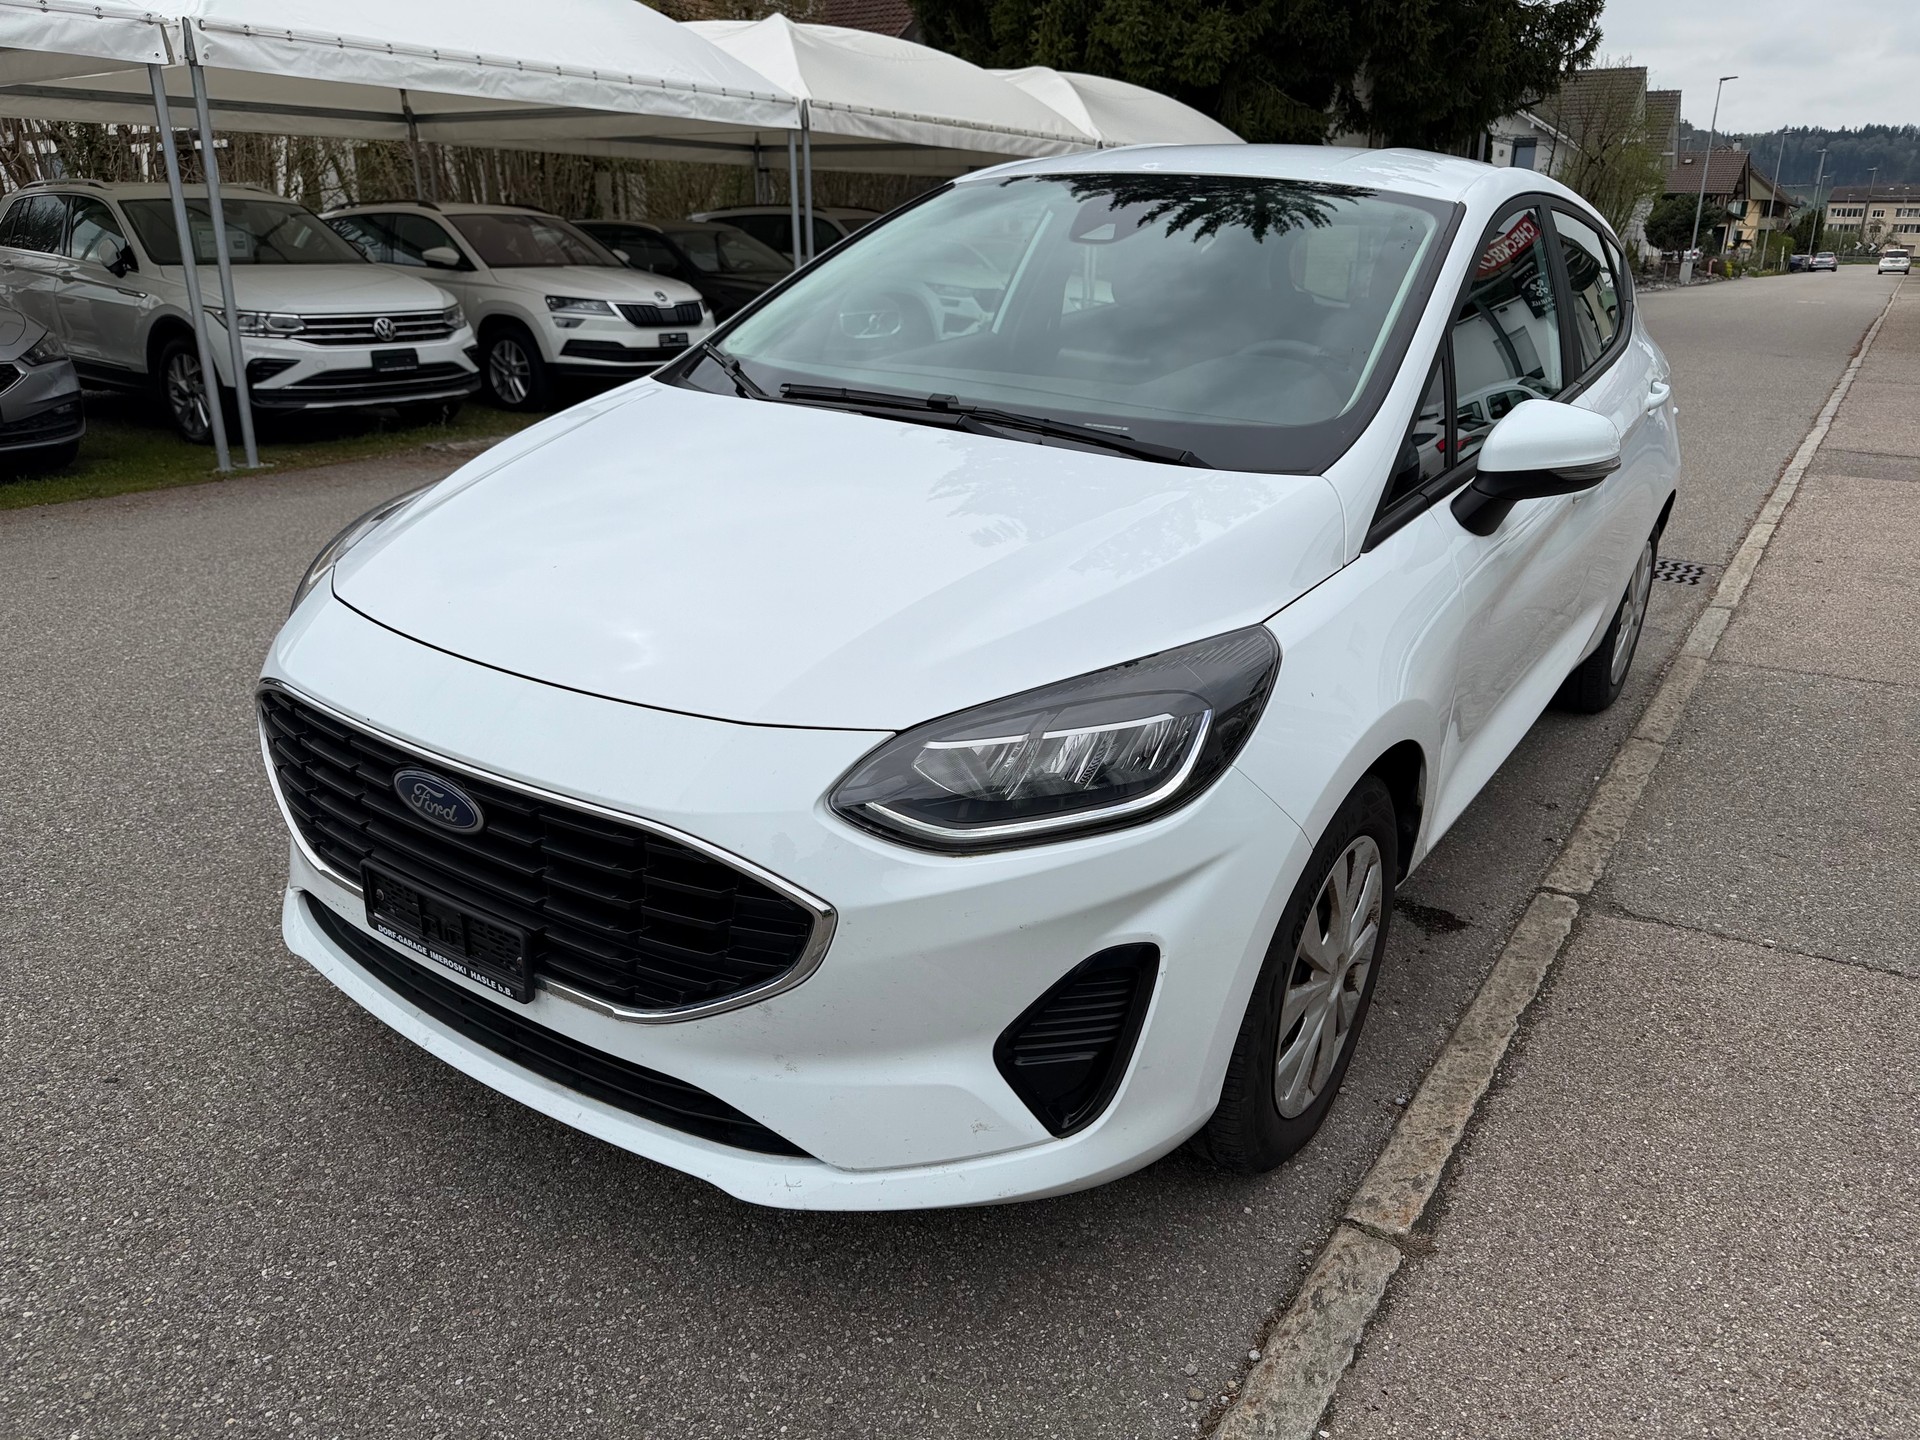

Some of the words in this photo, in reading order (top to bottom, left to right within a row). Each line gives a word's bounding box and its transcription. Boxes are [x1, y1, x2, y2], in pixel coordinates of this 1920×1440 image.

[411, 783, 458, 822] Ford
[377, 924, 428, 955] DORF-GARAGE
[429, 950, 467, 975] IMEROSKI
[470, 970, 497, 989] HASLE
